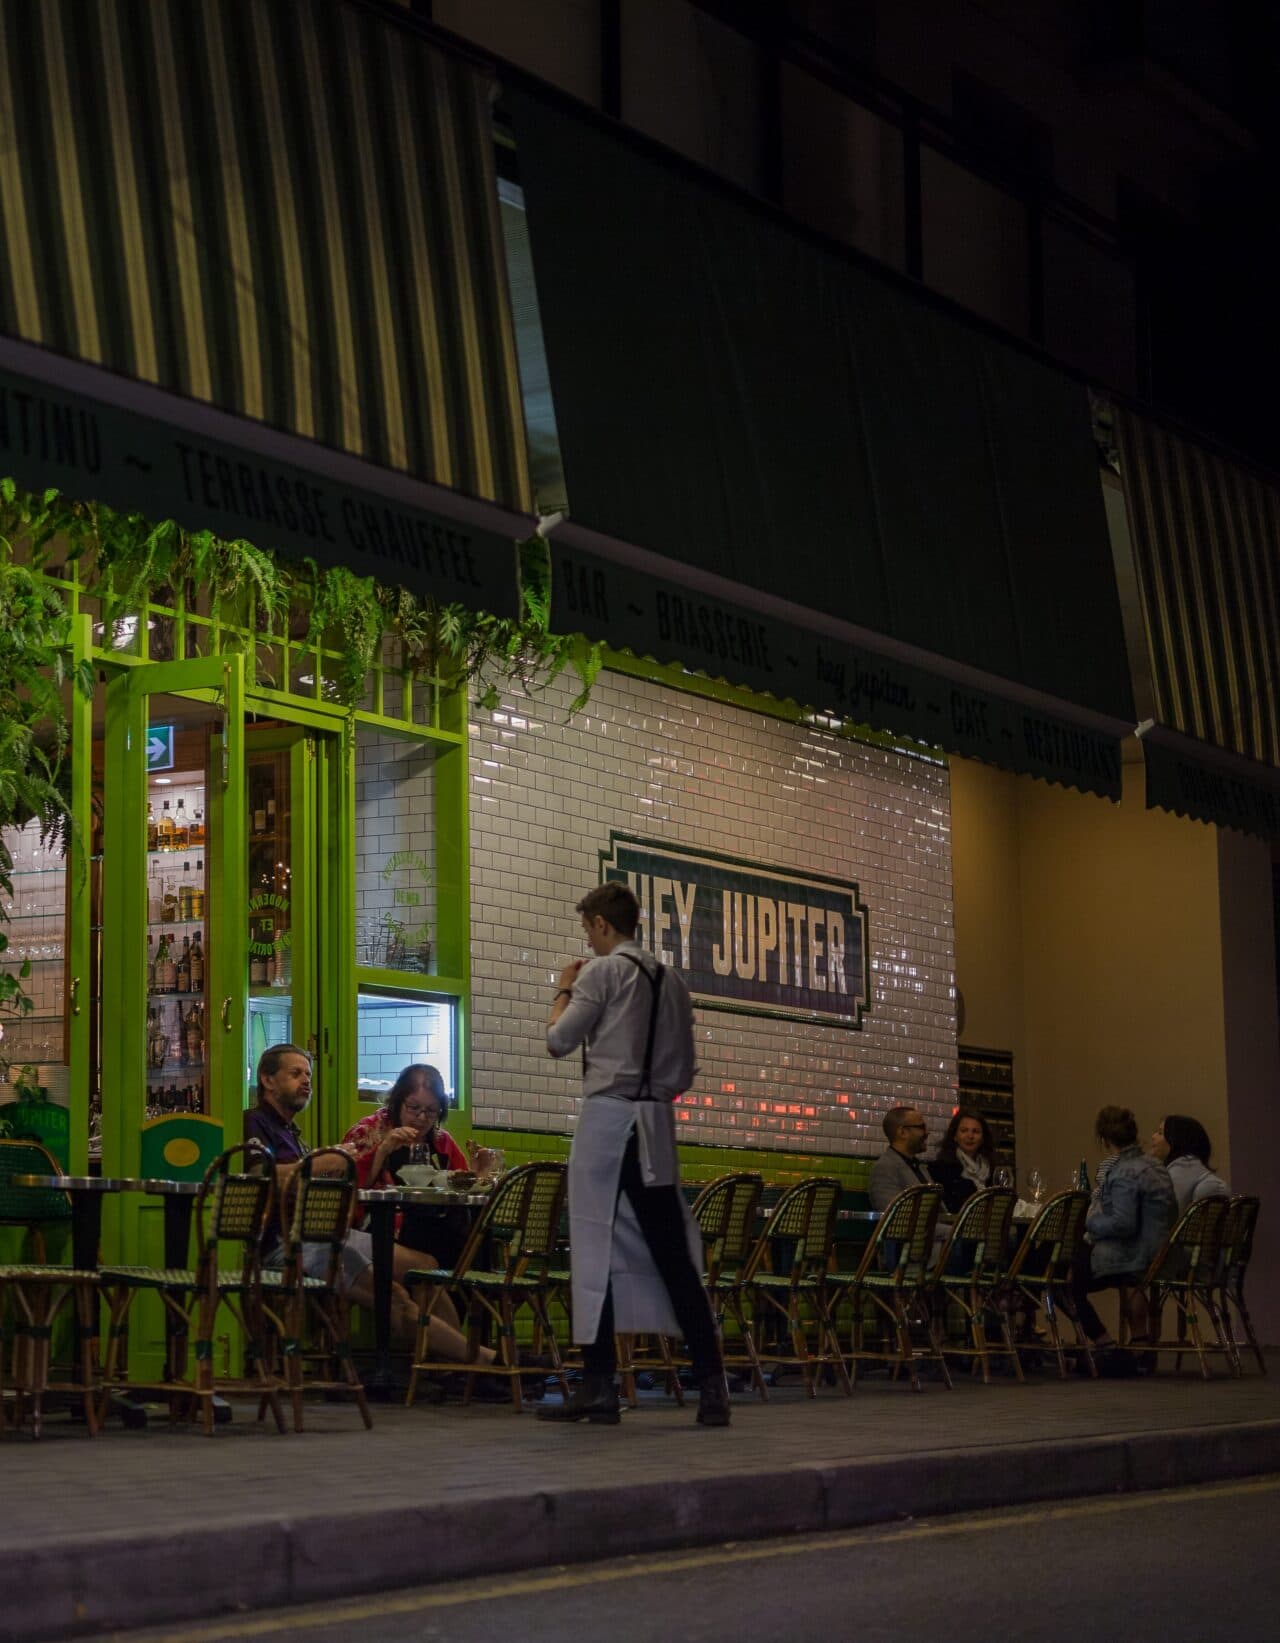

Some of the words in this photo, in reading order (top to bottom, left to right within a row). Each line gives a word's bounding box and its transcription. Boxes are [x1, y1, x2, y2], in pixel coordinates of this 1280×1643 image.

[172, 440, 336, 544] TERRASSE
[562, 560, 610, 624] BAR
[656, 590, 773, 672] BRASSERIE
[627, 870, 697, 969] HEY
[712, 889, 848, 995] JUPITER
